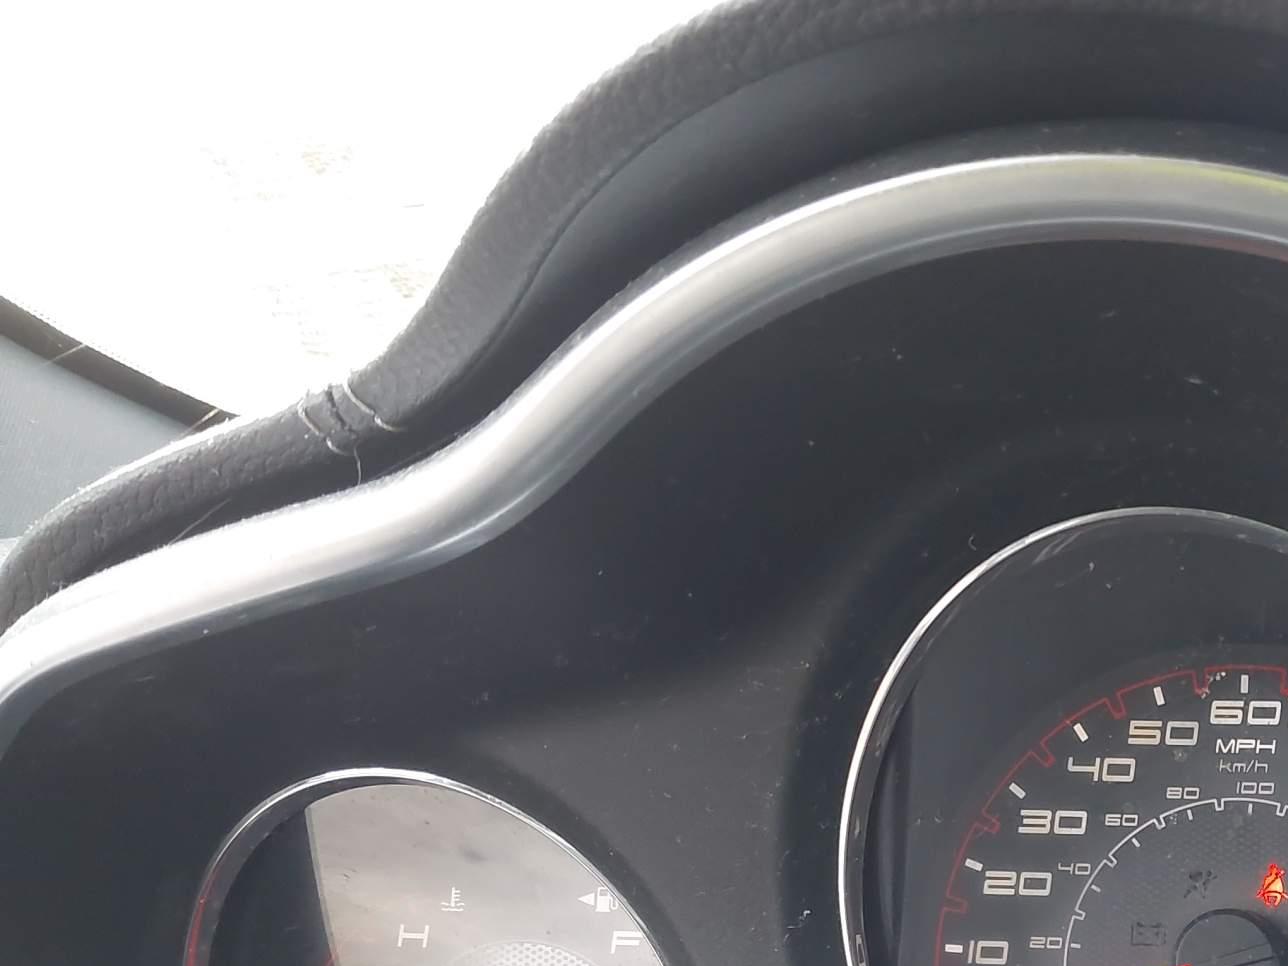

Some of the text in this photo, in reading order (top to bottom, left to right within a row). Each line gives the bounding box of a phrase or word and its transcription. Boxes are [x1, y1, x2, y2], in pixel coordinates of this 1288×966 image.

[1210, 701, 1281, 725] 60
[1128, 721, 1199, 746] 50
[1216, 739, 1276, 755] MPH
[1068, 757, 1135, 783] 40
[1219, 759, 1269, 774] km/h
[1166, 787, 1199, 800] 80
[1236, 782, 1274, 795] 100
[1017, 810, 1088, 836] 30
[1105, 814, 1138, 827] 60
[1058, 863, 1091, 875] 40
[983, 872, 1052, 897] 20
[398, 924, 430, 948] H
[611, 930, 643, 954] F
[1029, 936, 1062, 949] 20
[968, 940, 1008, 965] 10
